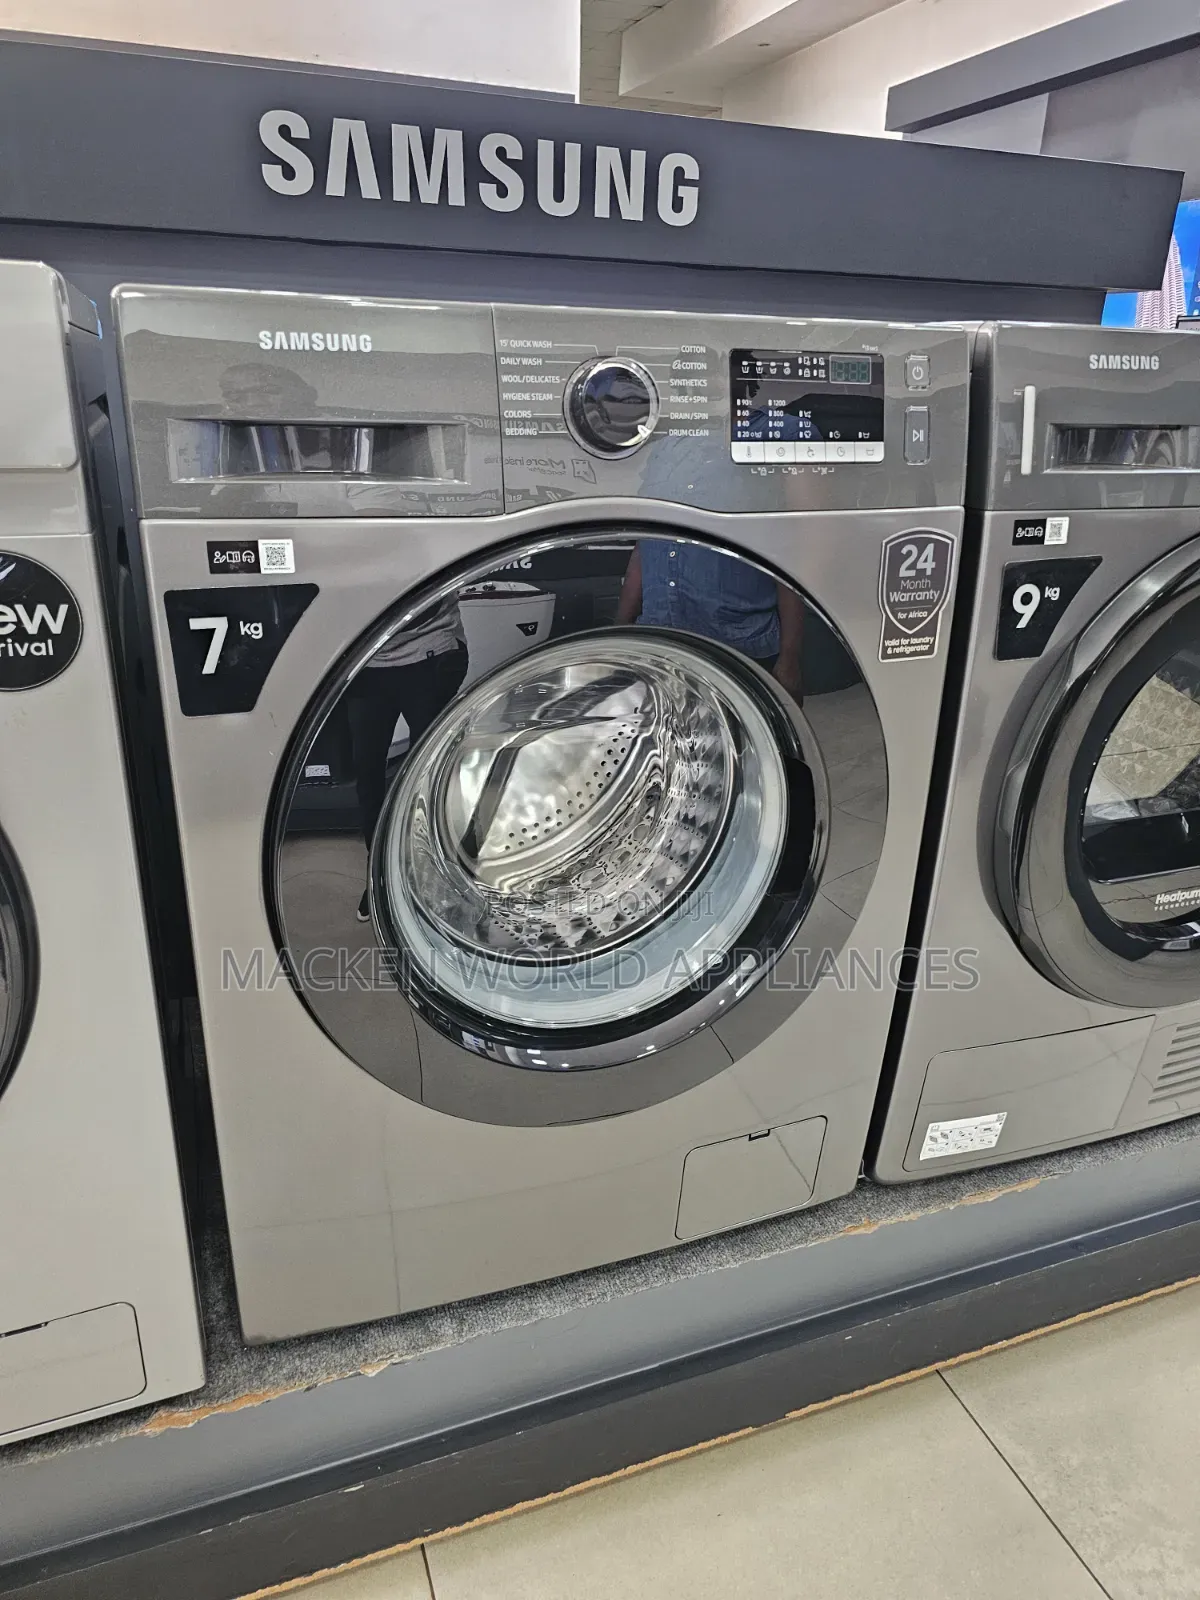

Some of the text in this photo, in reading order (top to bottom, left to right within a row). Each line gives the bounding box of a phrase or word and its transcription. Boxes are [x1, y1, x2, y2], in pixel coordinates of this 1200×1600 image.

[258, 109, 700, 227] SAMSUNG
[258, 330, 373, 353] SAMSUNG
[510, 340, 532, 348] QUICK
[532, 340, 552, 349] WASH
[681, 345, 706, 353] COTTON
[500, 357, 542, 365] DAILY WASH
[1089, 354, 1160, 370] SAMSUNG
[501, 375, 560, 383] WOOL/DELICATES
[669, 379, 708, 387] SYNTHETICS
[502, 392, 553, 401] HYGIENE STEAM
[503, 410, 532, 418] COLORS
[505, 428, 538, 436] BEDDING
[688, 429, 709, 437] CLEAN
[899, 543, 936, 577] 24
[900, 579, 932, 590] Month
[889, 590, 940, 602] Warranty
[1012, 583, 1060, 629] 9 kg
[897, 610, 928, 619] for Africa
[189, 616, 264, 675] 7 kg
[884, 638, 899, 646] Valid
[910, 636, 934, 645] laundry
[893, 645, 930, 654] refrigerator
